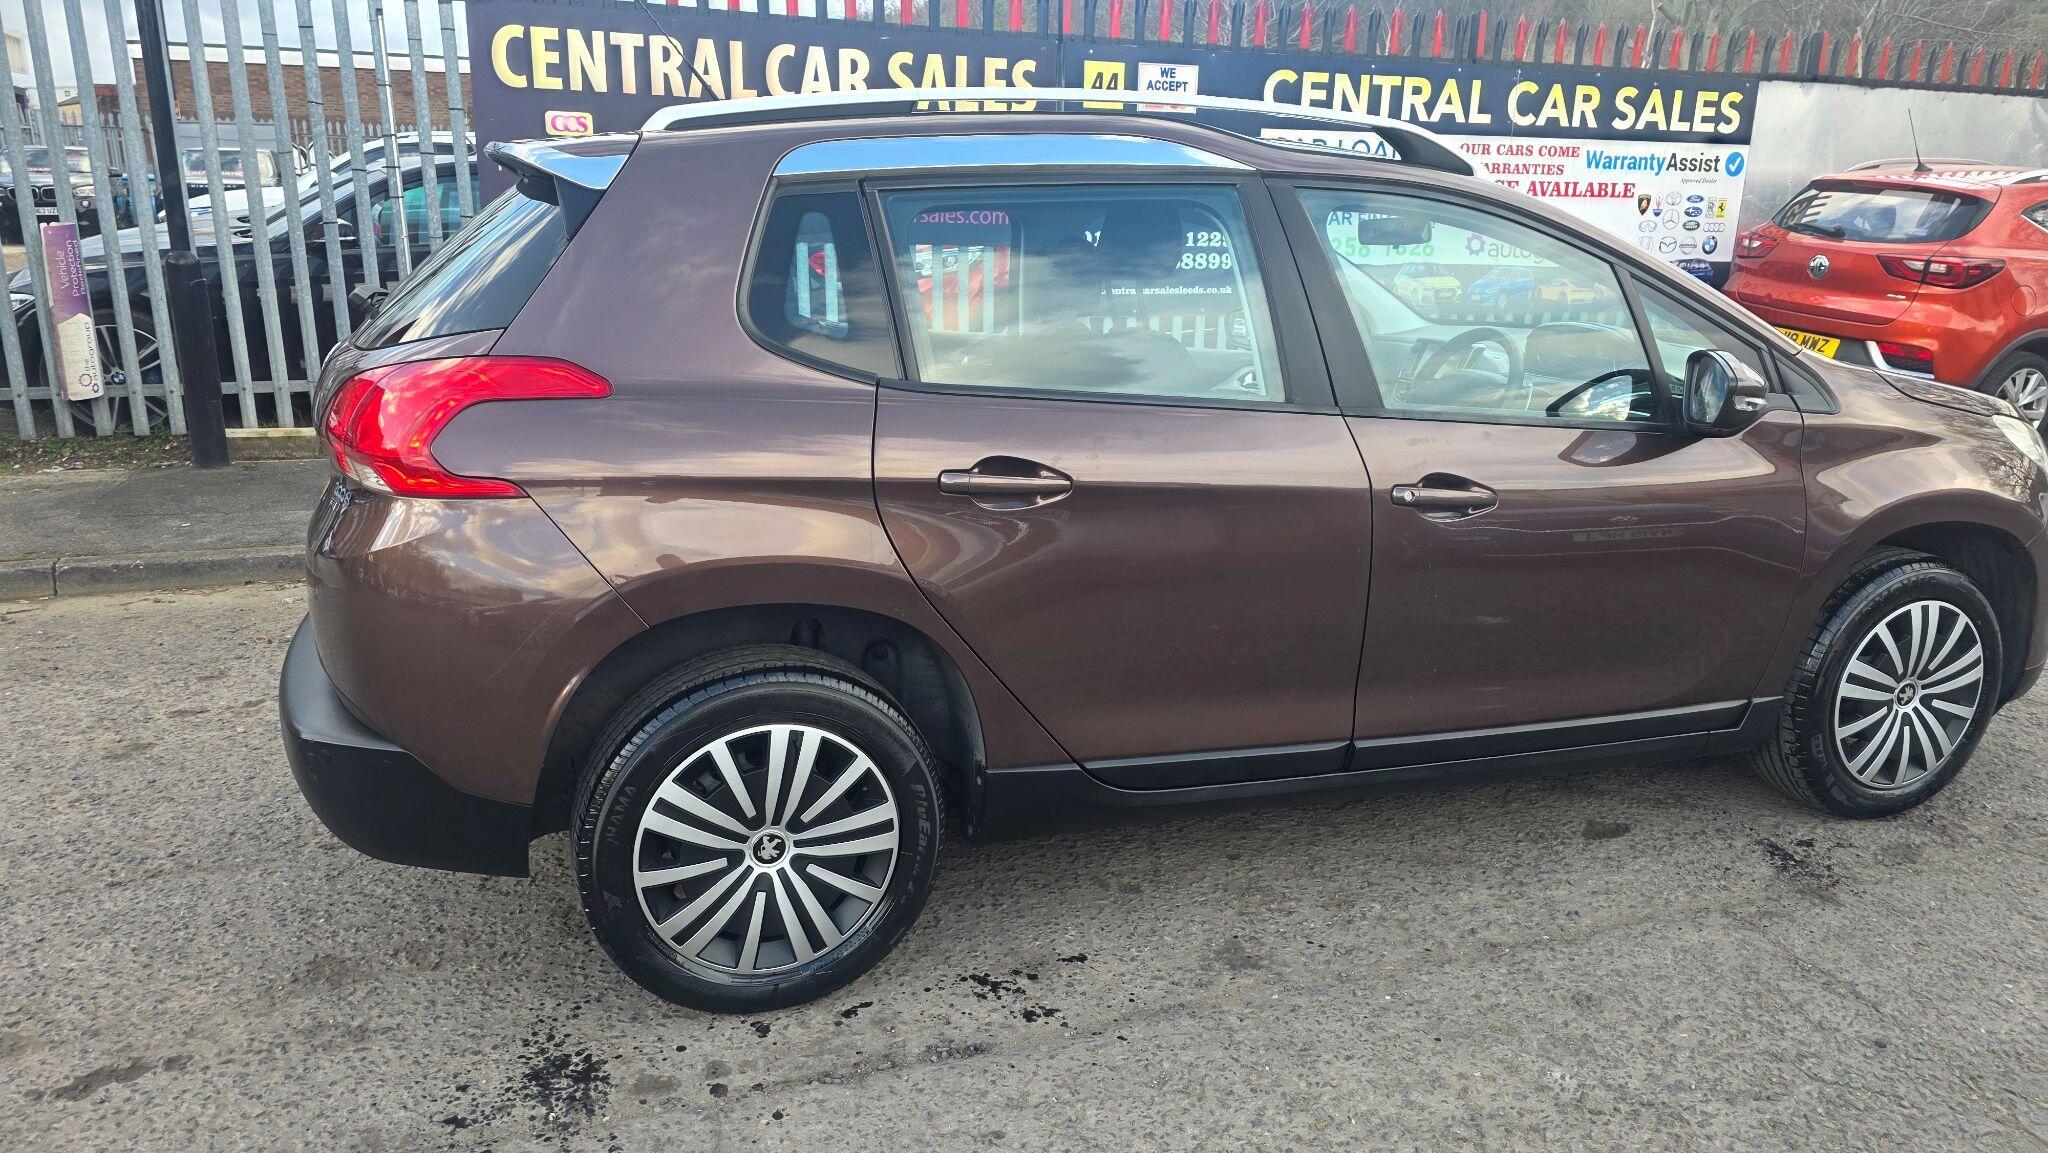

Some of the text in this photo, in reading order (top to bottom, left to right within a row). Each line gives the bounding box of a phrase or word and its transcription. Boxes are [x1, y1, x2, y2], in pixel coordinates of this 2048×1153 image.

[491, 24, 1037, 112] CENTRAL CAR SALES
[1160, 67, 1177, 79] WE
[1091, 71, 1119, 91] AA
[1146, 80, 1189, 93] ACCEPT
[1263, 69, 1744, 134] CENTRAL CAR SALES
[1492, 143, 1533, 157] CARS
[1538, 145, 1581, 158] COME
[1526, 180, 1636, 199] AVAILABLE
[66, 239, 82, 298] Protection
